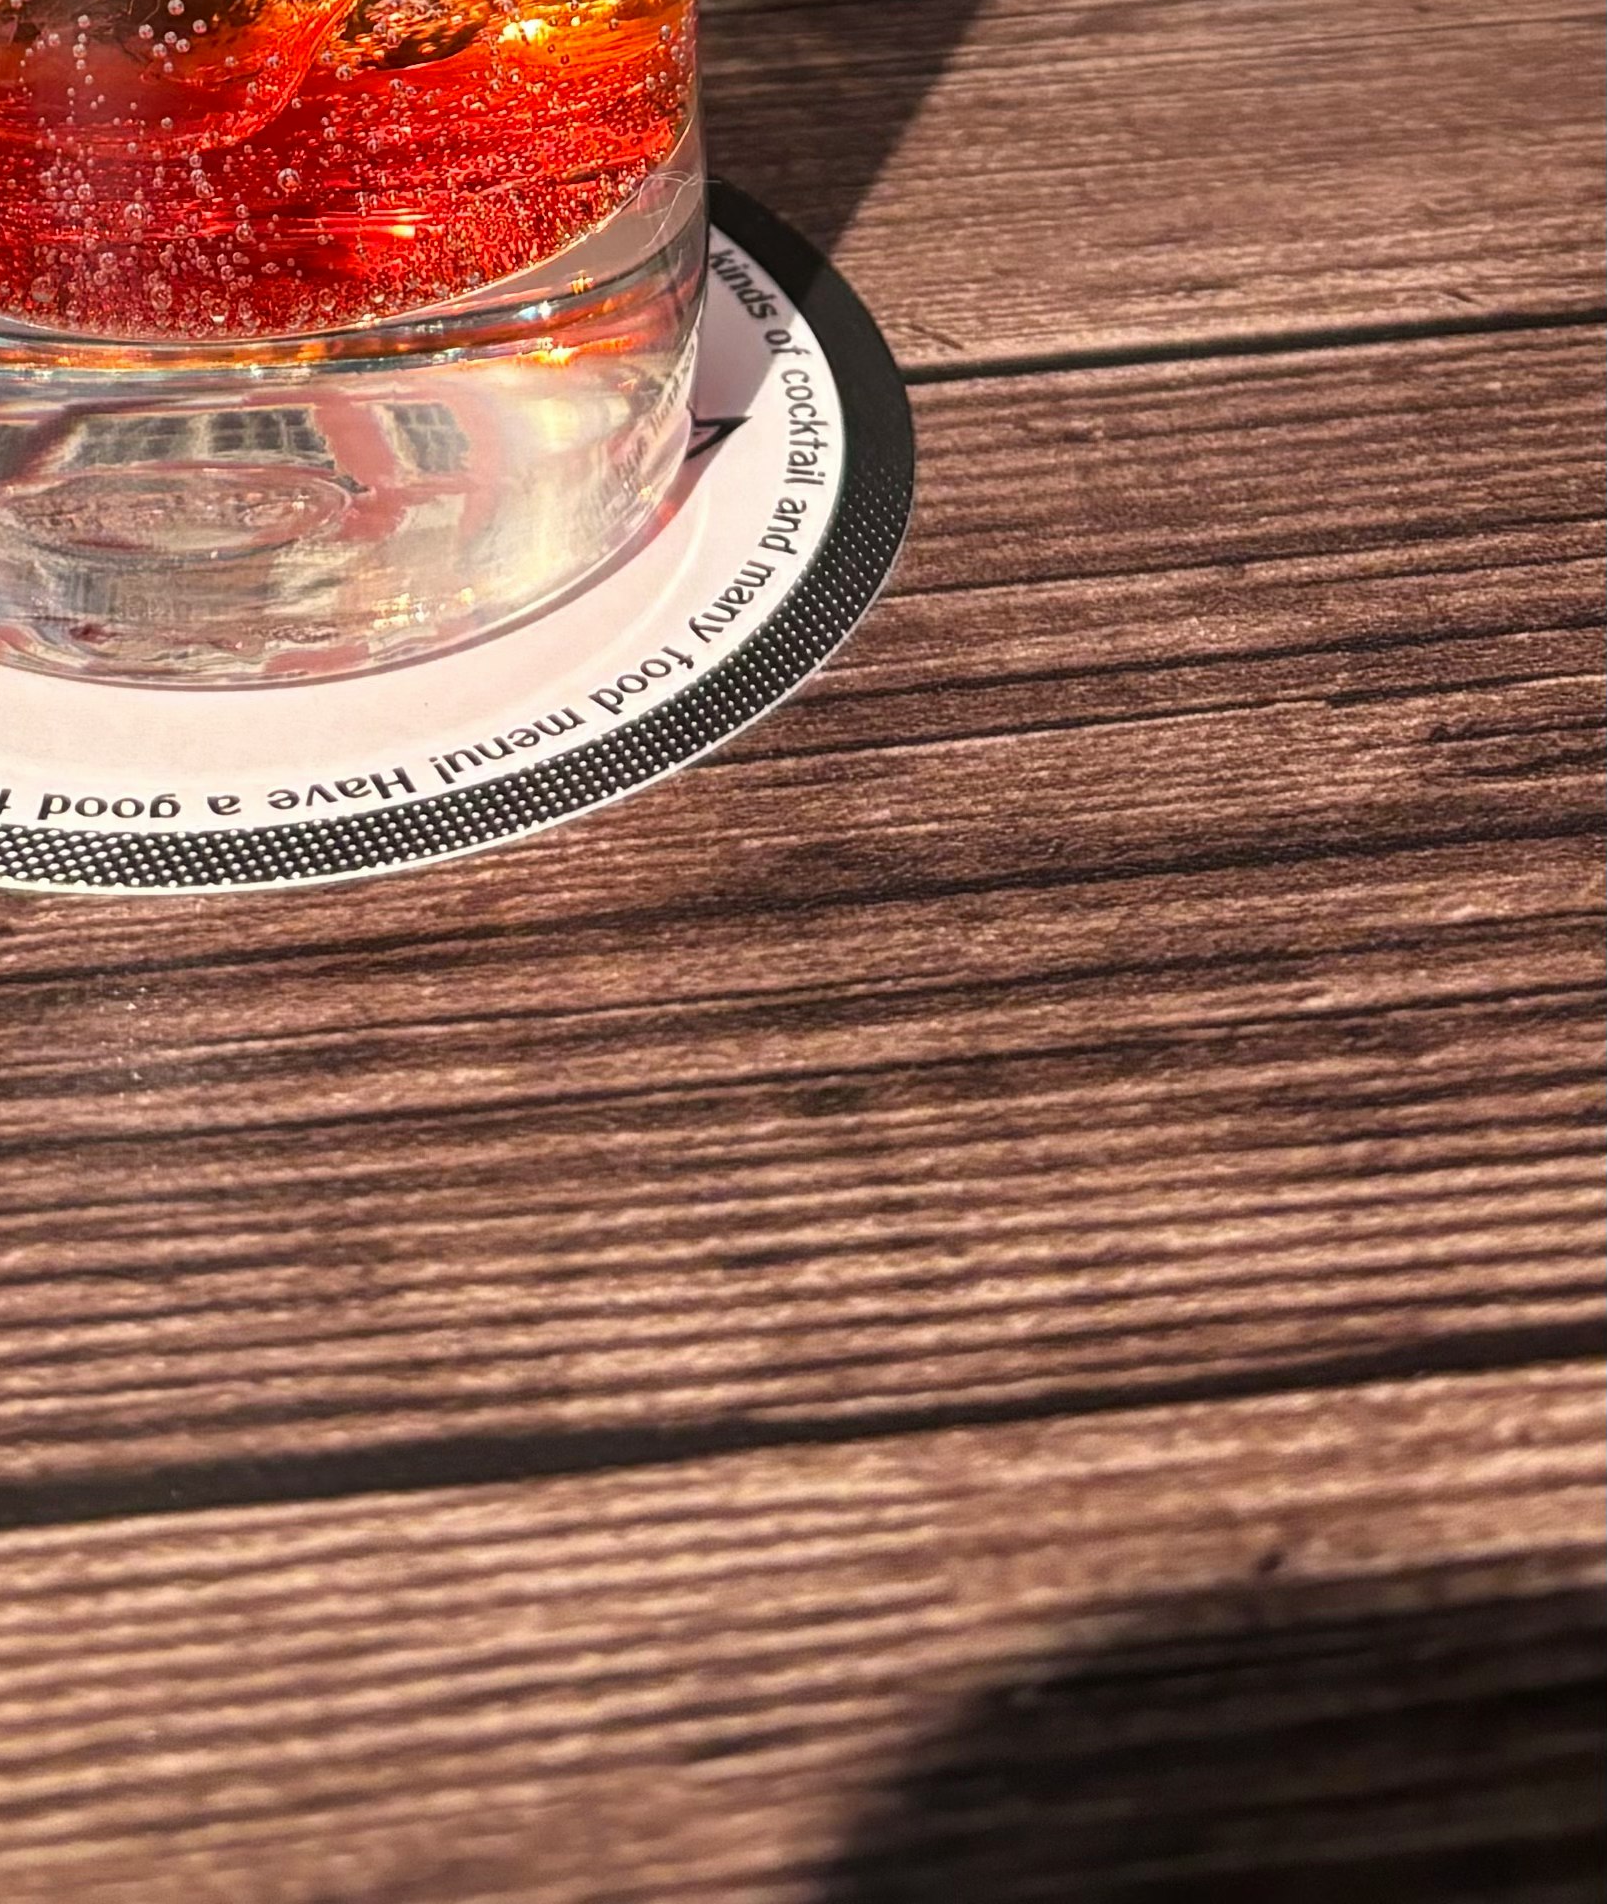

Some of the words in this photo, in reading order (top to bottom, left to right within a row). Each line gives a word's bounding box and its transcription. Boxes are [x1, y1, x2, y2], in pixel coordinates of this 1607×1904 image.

[709, 248, 778, 319] kinds
[766, 328, 806, 362] of
[781, 367, 830, 488] cocktail
[757, 497, 809, 557] and
[688, 558, 778, 643] many
[587, 644, 697, 715] food
[431, 706, 585, 786] menu!
[38, 791, 182, 821] good
[209, 795, 244, 816] a
[268, 766, 417, 811] Have
